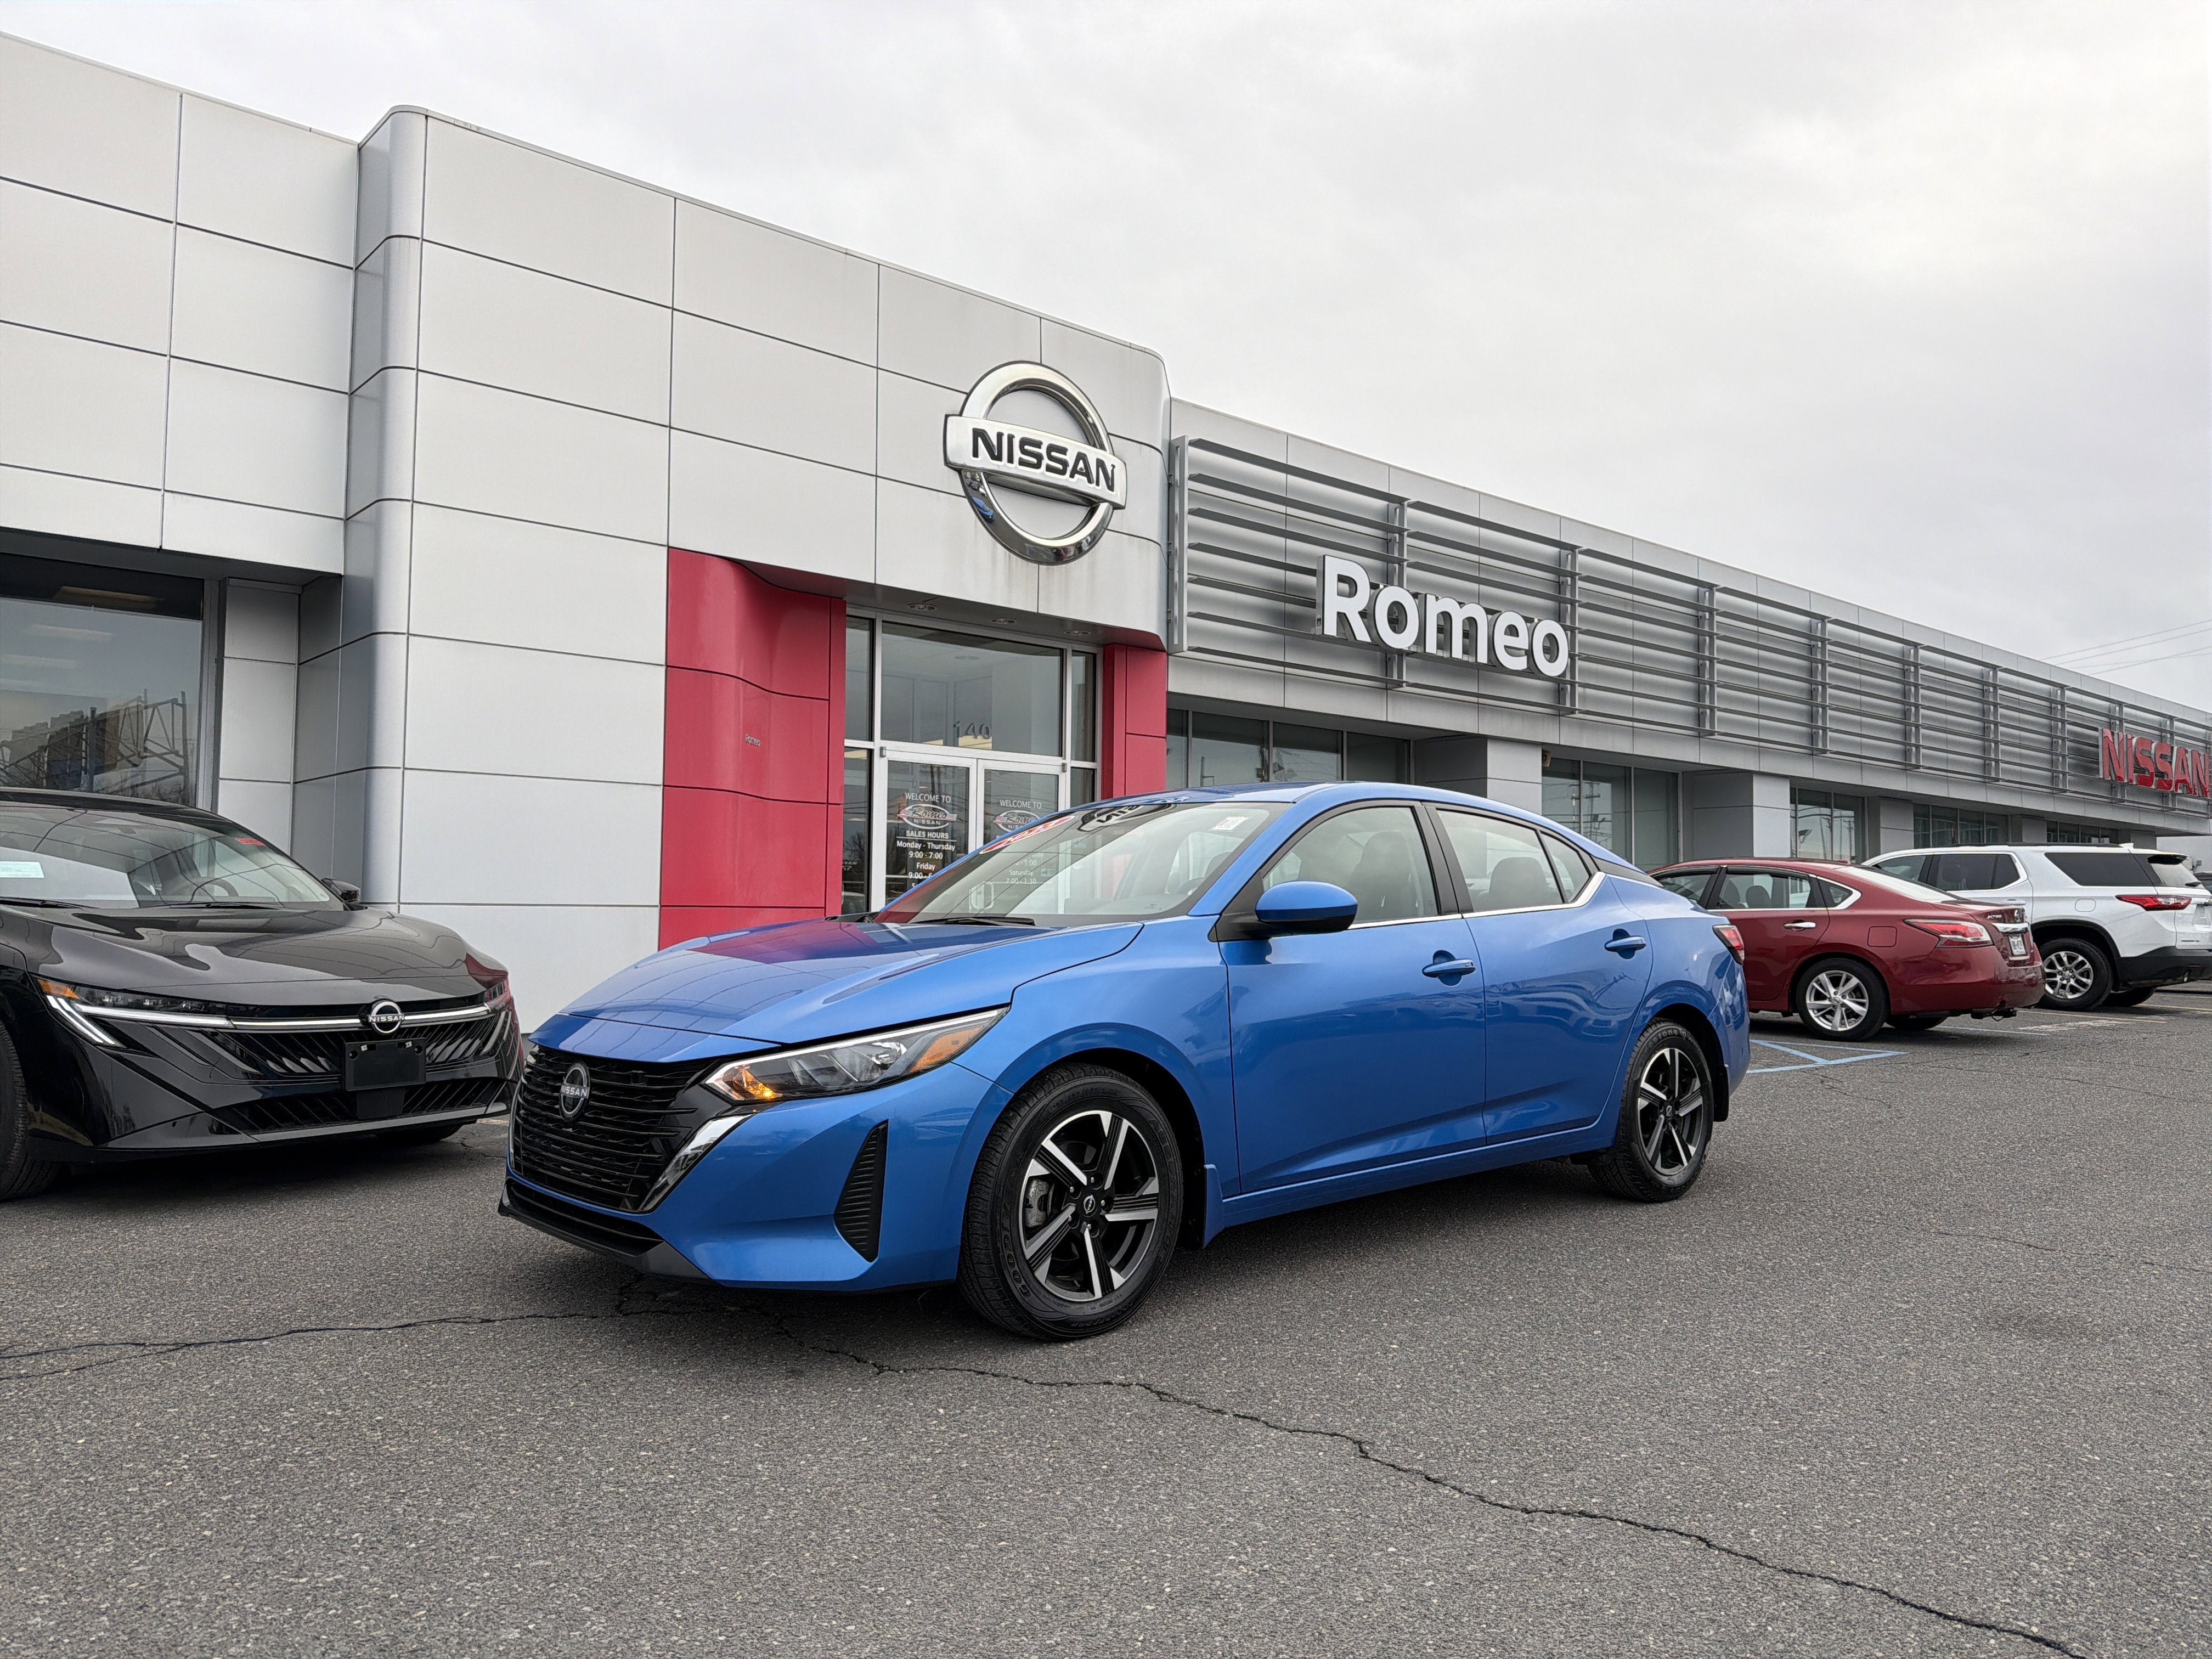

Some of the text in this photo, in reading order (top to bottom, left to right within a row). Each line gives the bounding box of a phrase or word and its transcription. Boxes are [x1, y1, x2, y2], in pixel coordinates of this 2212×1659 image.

[972, 427, 1115, 492] NISSAN
[1321, 554, 1569, 677] Romeo
[953, 720, 990, 740] 140
[2101, 728, 2210, 799] NISSAN
[905, 792, 939, 802] WELCOME
[1000, 799, 1031, 808] WELCOME
[911, 806, 948, 818] Romeo
[896, 840, 922, 849] Monday
[927, 842, 955, 851] Thursday
[916, 862, 936, 871] Friday
[561, 1085, 588, 1097] NISSAN
